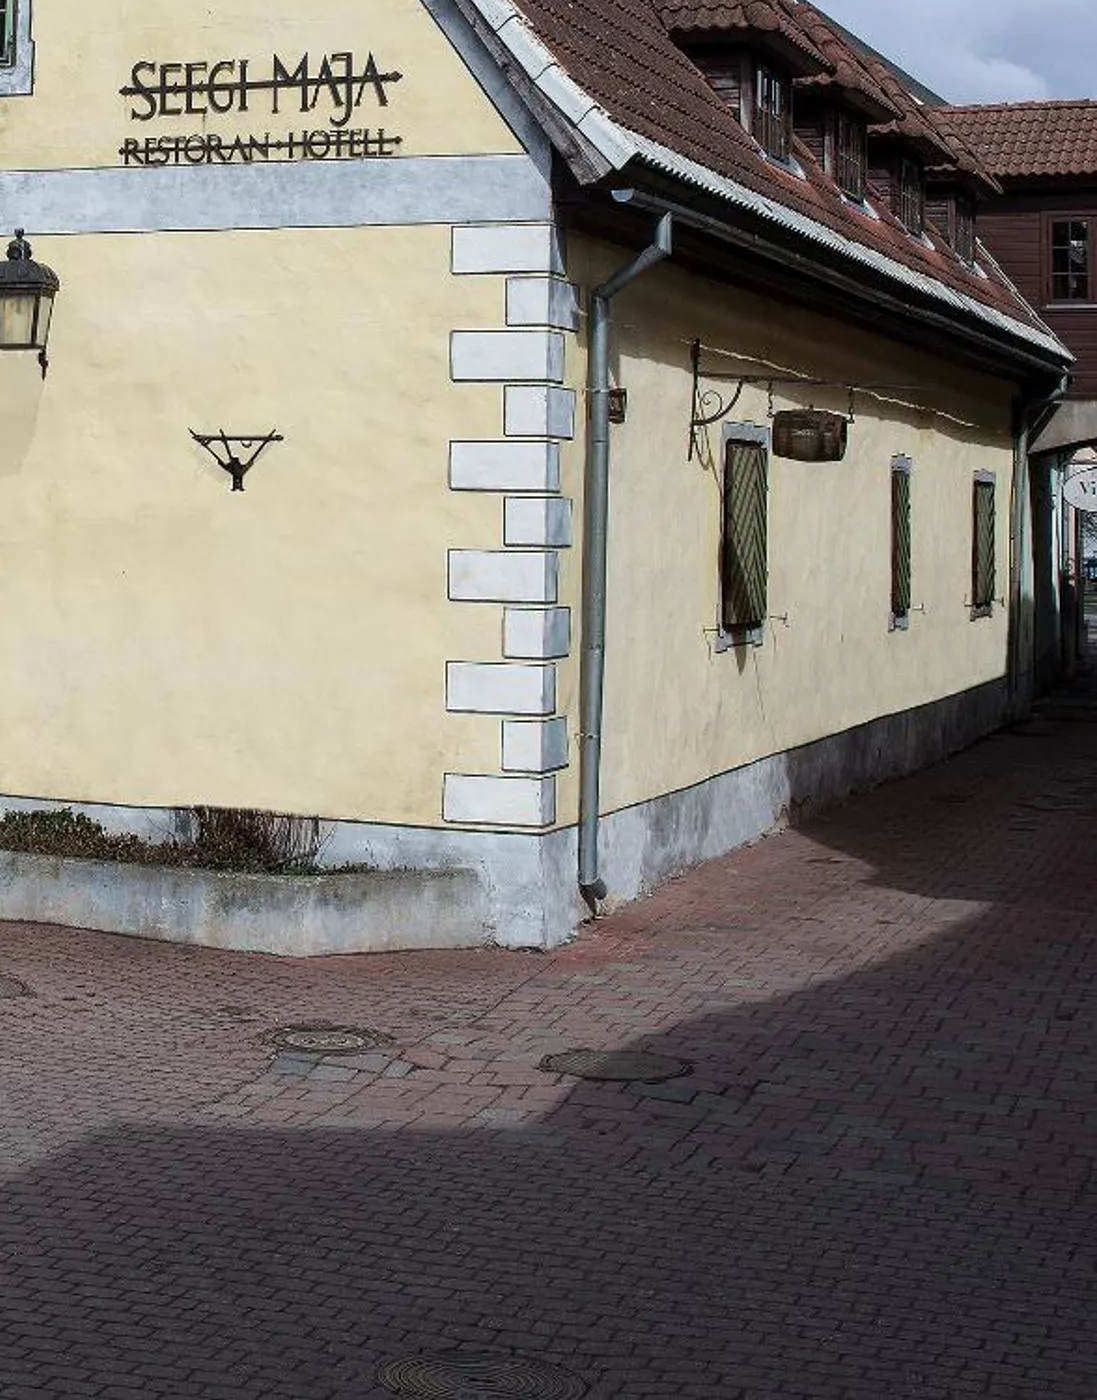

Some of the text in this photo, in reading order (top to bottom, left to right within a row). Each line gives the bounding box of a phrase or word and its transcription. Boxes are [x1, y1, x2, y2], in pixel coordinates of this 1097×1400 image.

[130, 51, 389, 127] SEEGI MAJA
[124, 128, 394, 165] RESTORAN HOTELL
